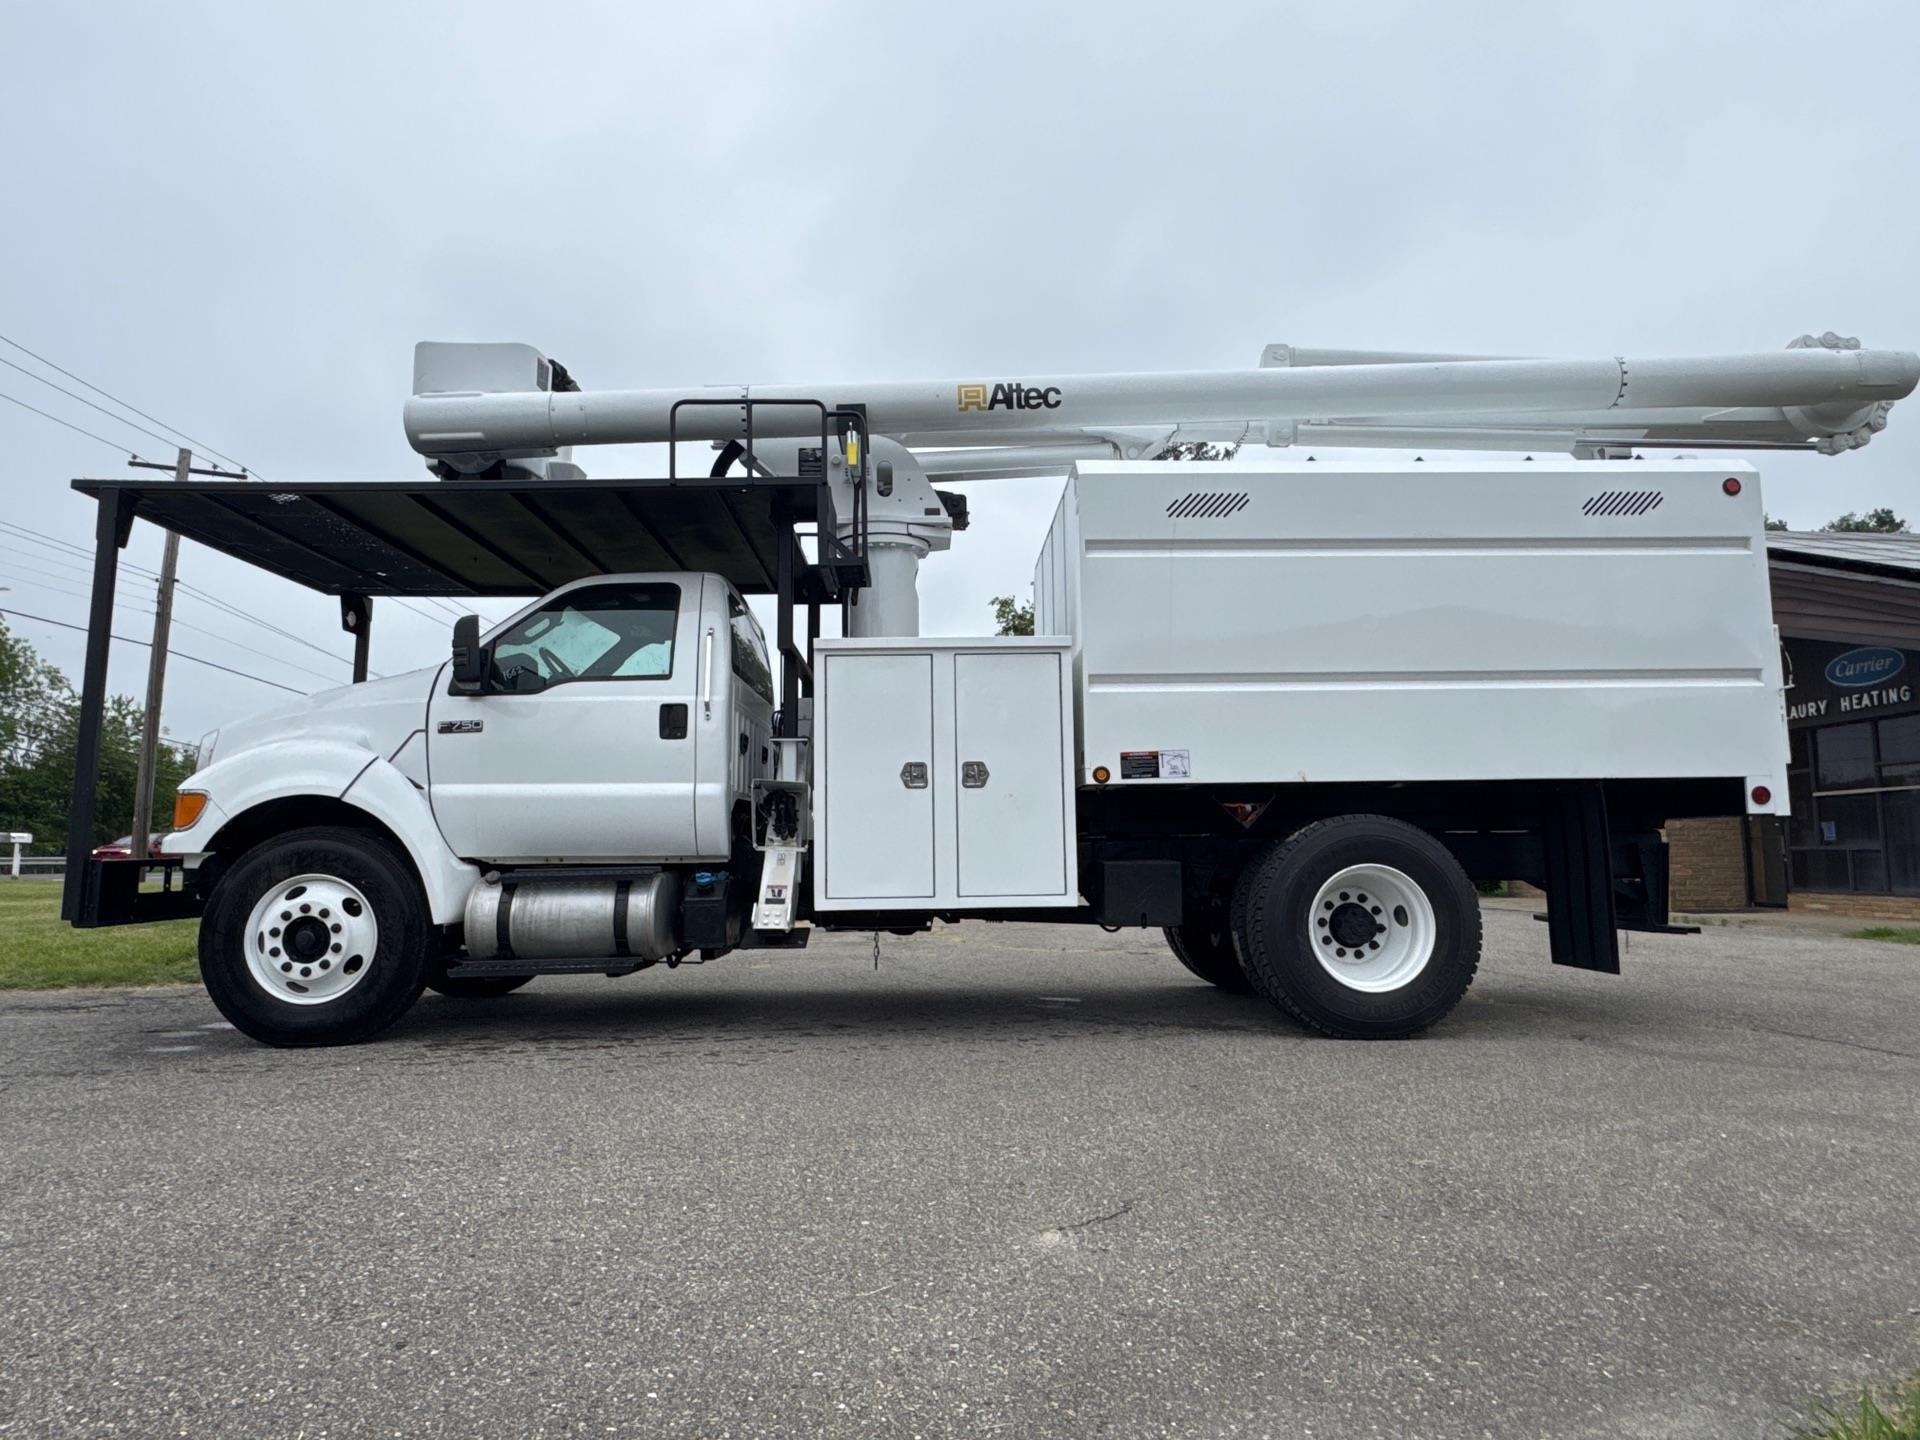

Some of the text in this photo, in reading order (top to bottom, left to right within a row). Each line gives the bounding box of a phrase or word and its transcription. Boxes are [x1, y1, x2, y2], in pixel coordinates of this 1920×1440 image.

[988, 383, 1062, 410] Altec
[1835, 655, 1894, 678] Carrier
[1787, 685, 1912, 721] AURY HEATING
